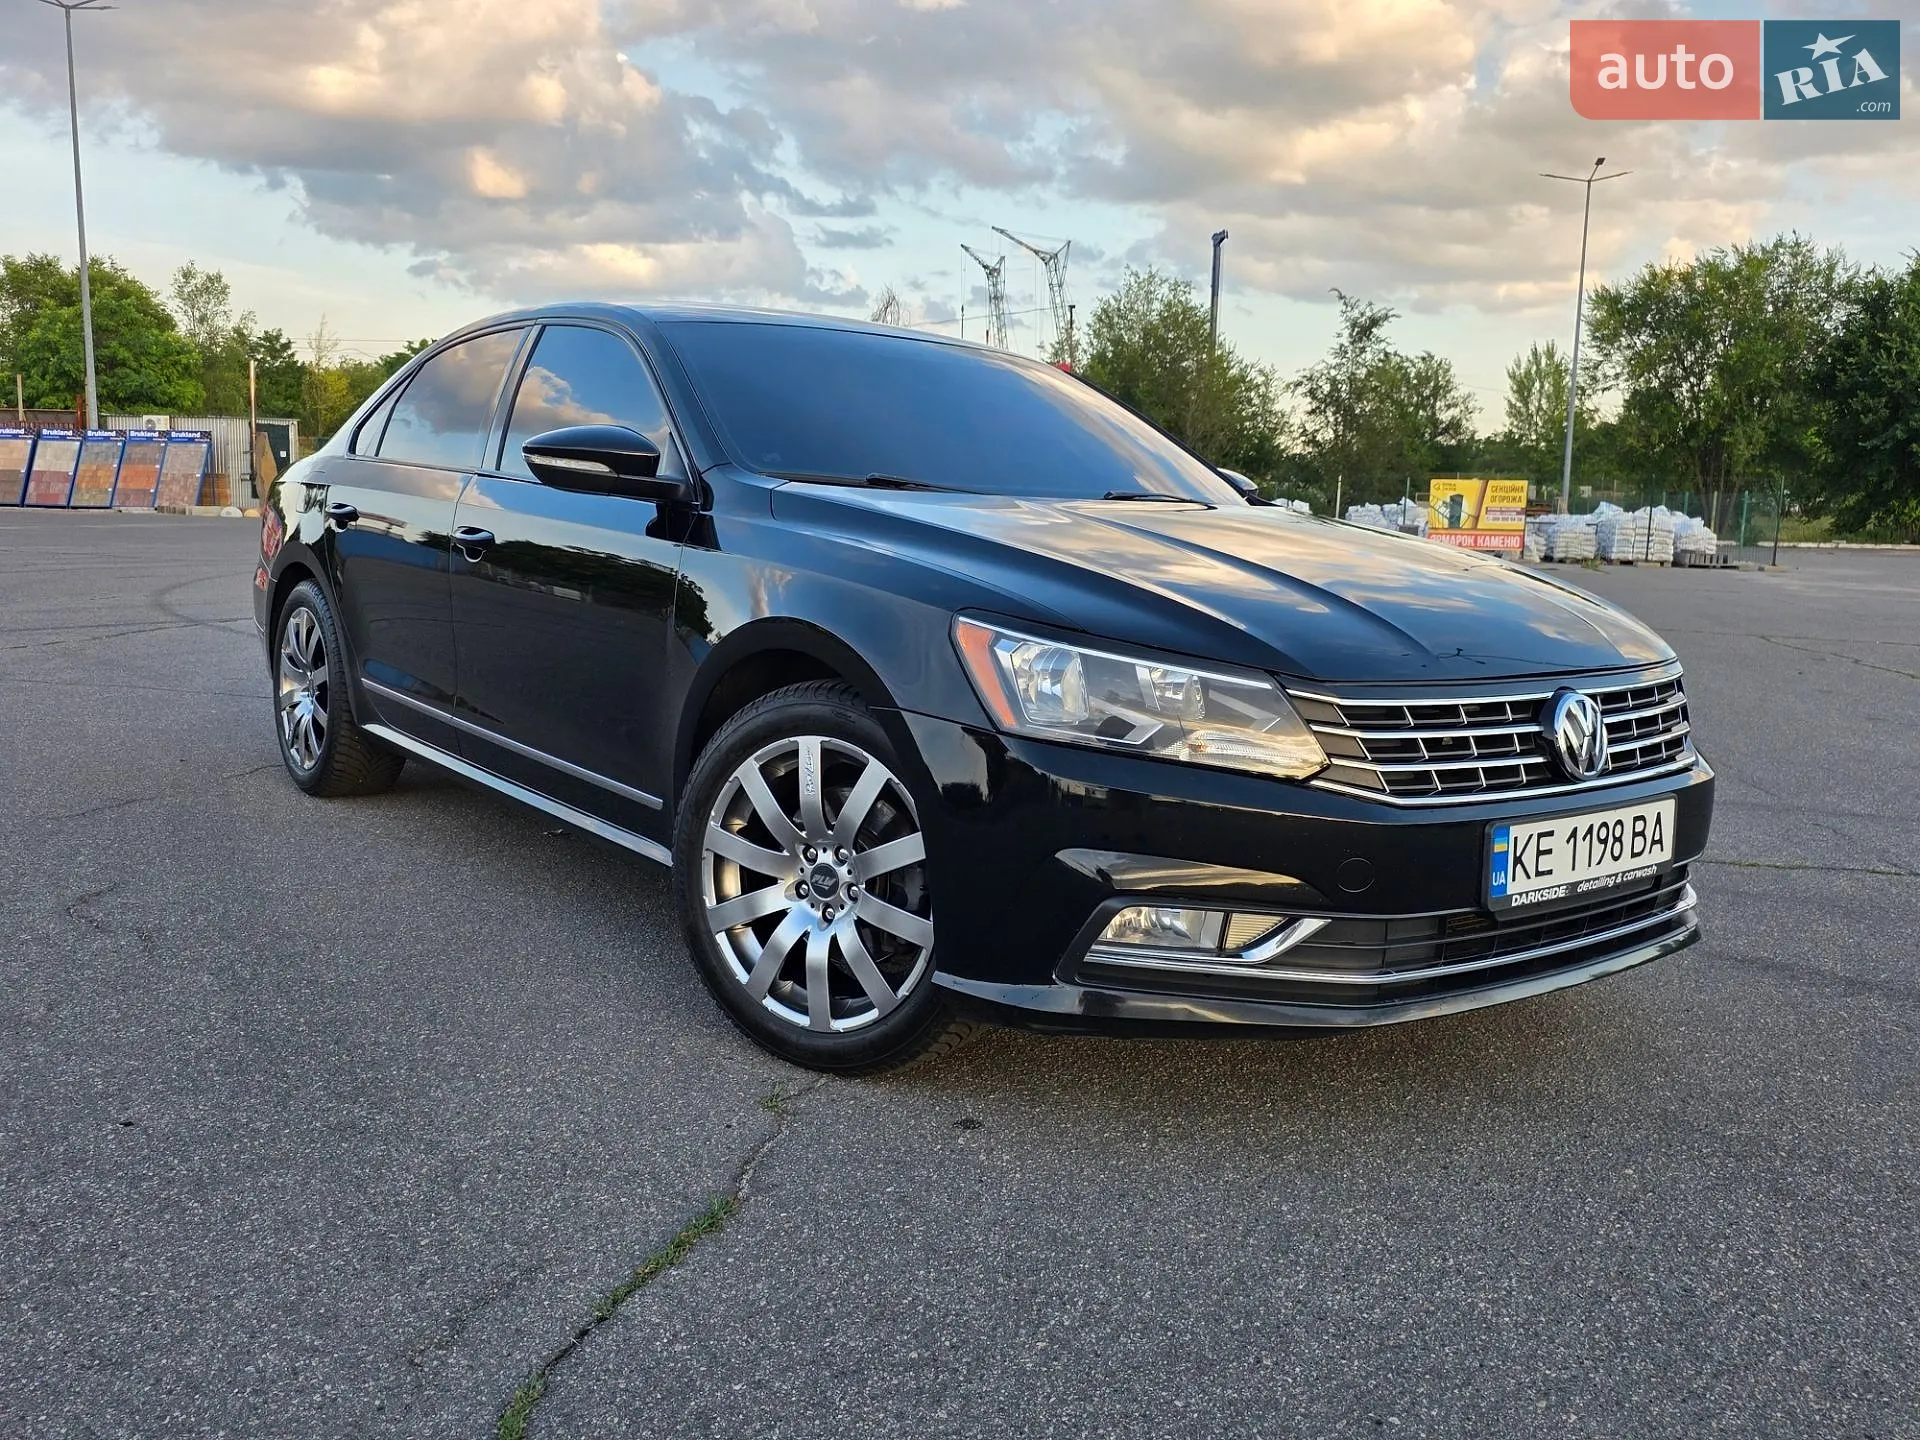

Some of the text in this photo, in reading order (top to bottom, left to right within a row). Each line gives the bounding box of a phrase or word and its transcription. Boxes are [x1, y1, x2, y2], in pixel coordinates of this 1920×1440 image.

[1490, 495, 1522, 504] ОГОРОЖА
[1477, 535, 1521, 547] КАМЕНЮ
[1511, 811, 1664, 882] KE 1198 BA
[1492, 871, 1506, 886] UA
[1577, 876, 1616, 893] detailing
[1616, 872, 1622, 883] &
[1623, 864, 1658, 881] carwash
